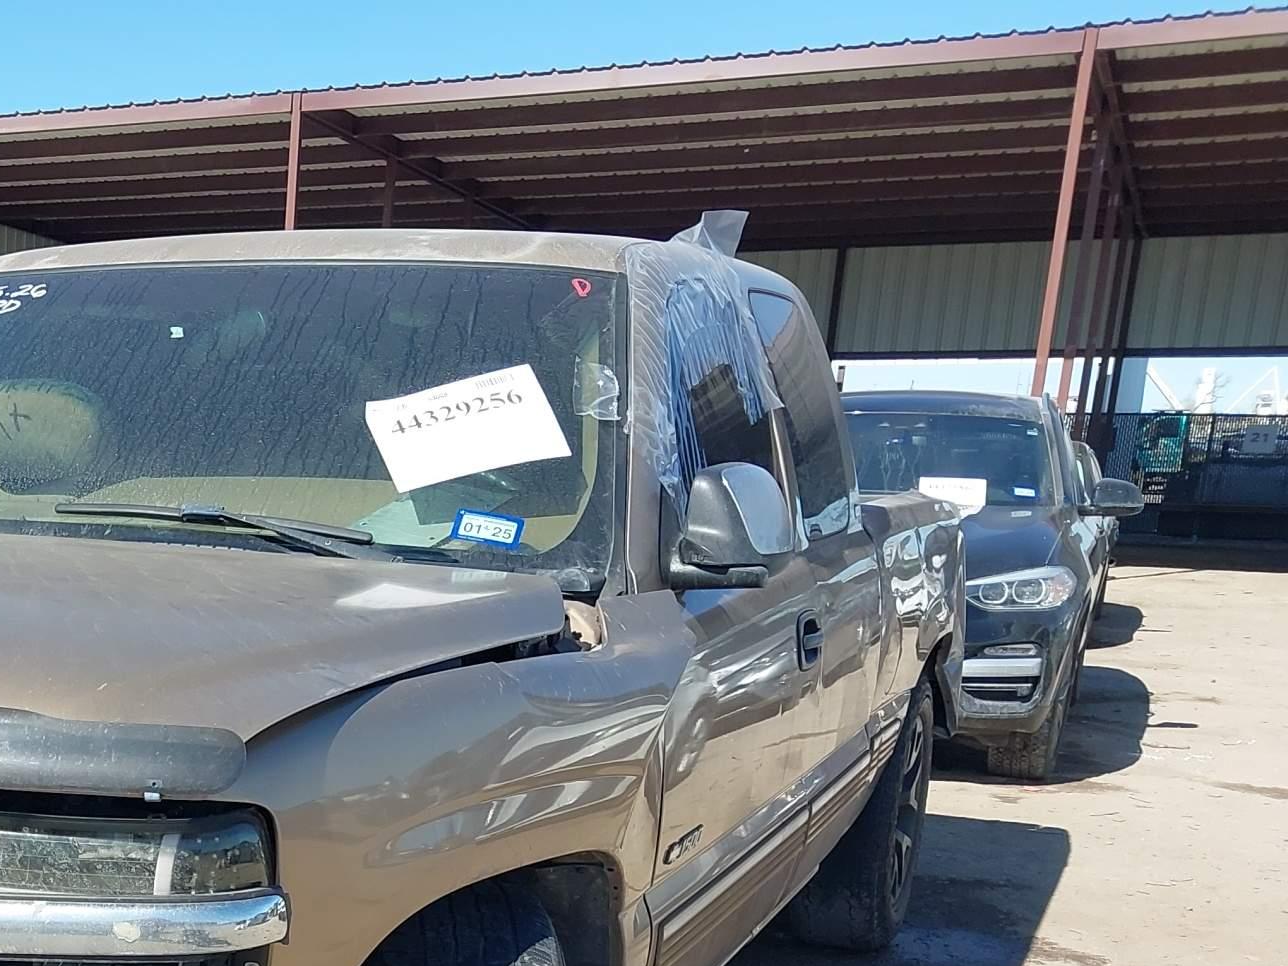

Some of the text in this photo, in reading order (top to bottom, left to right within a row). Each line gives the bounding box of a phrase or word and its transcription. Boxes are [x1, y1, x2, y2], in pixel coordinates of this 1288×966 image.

[391, 389, 523, 434] 44329256
[1251, 432, 1268, 443] 21
[463, 522, 482, 535] 01
[491, 526, 513, 540] 25
